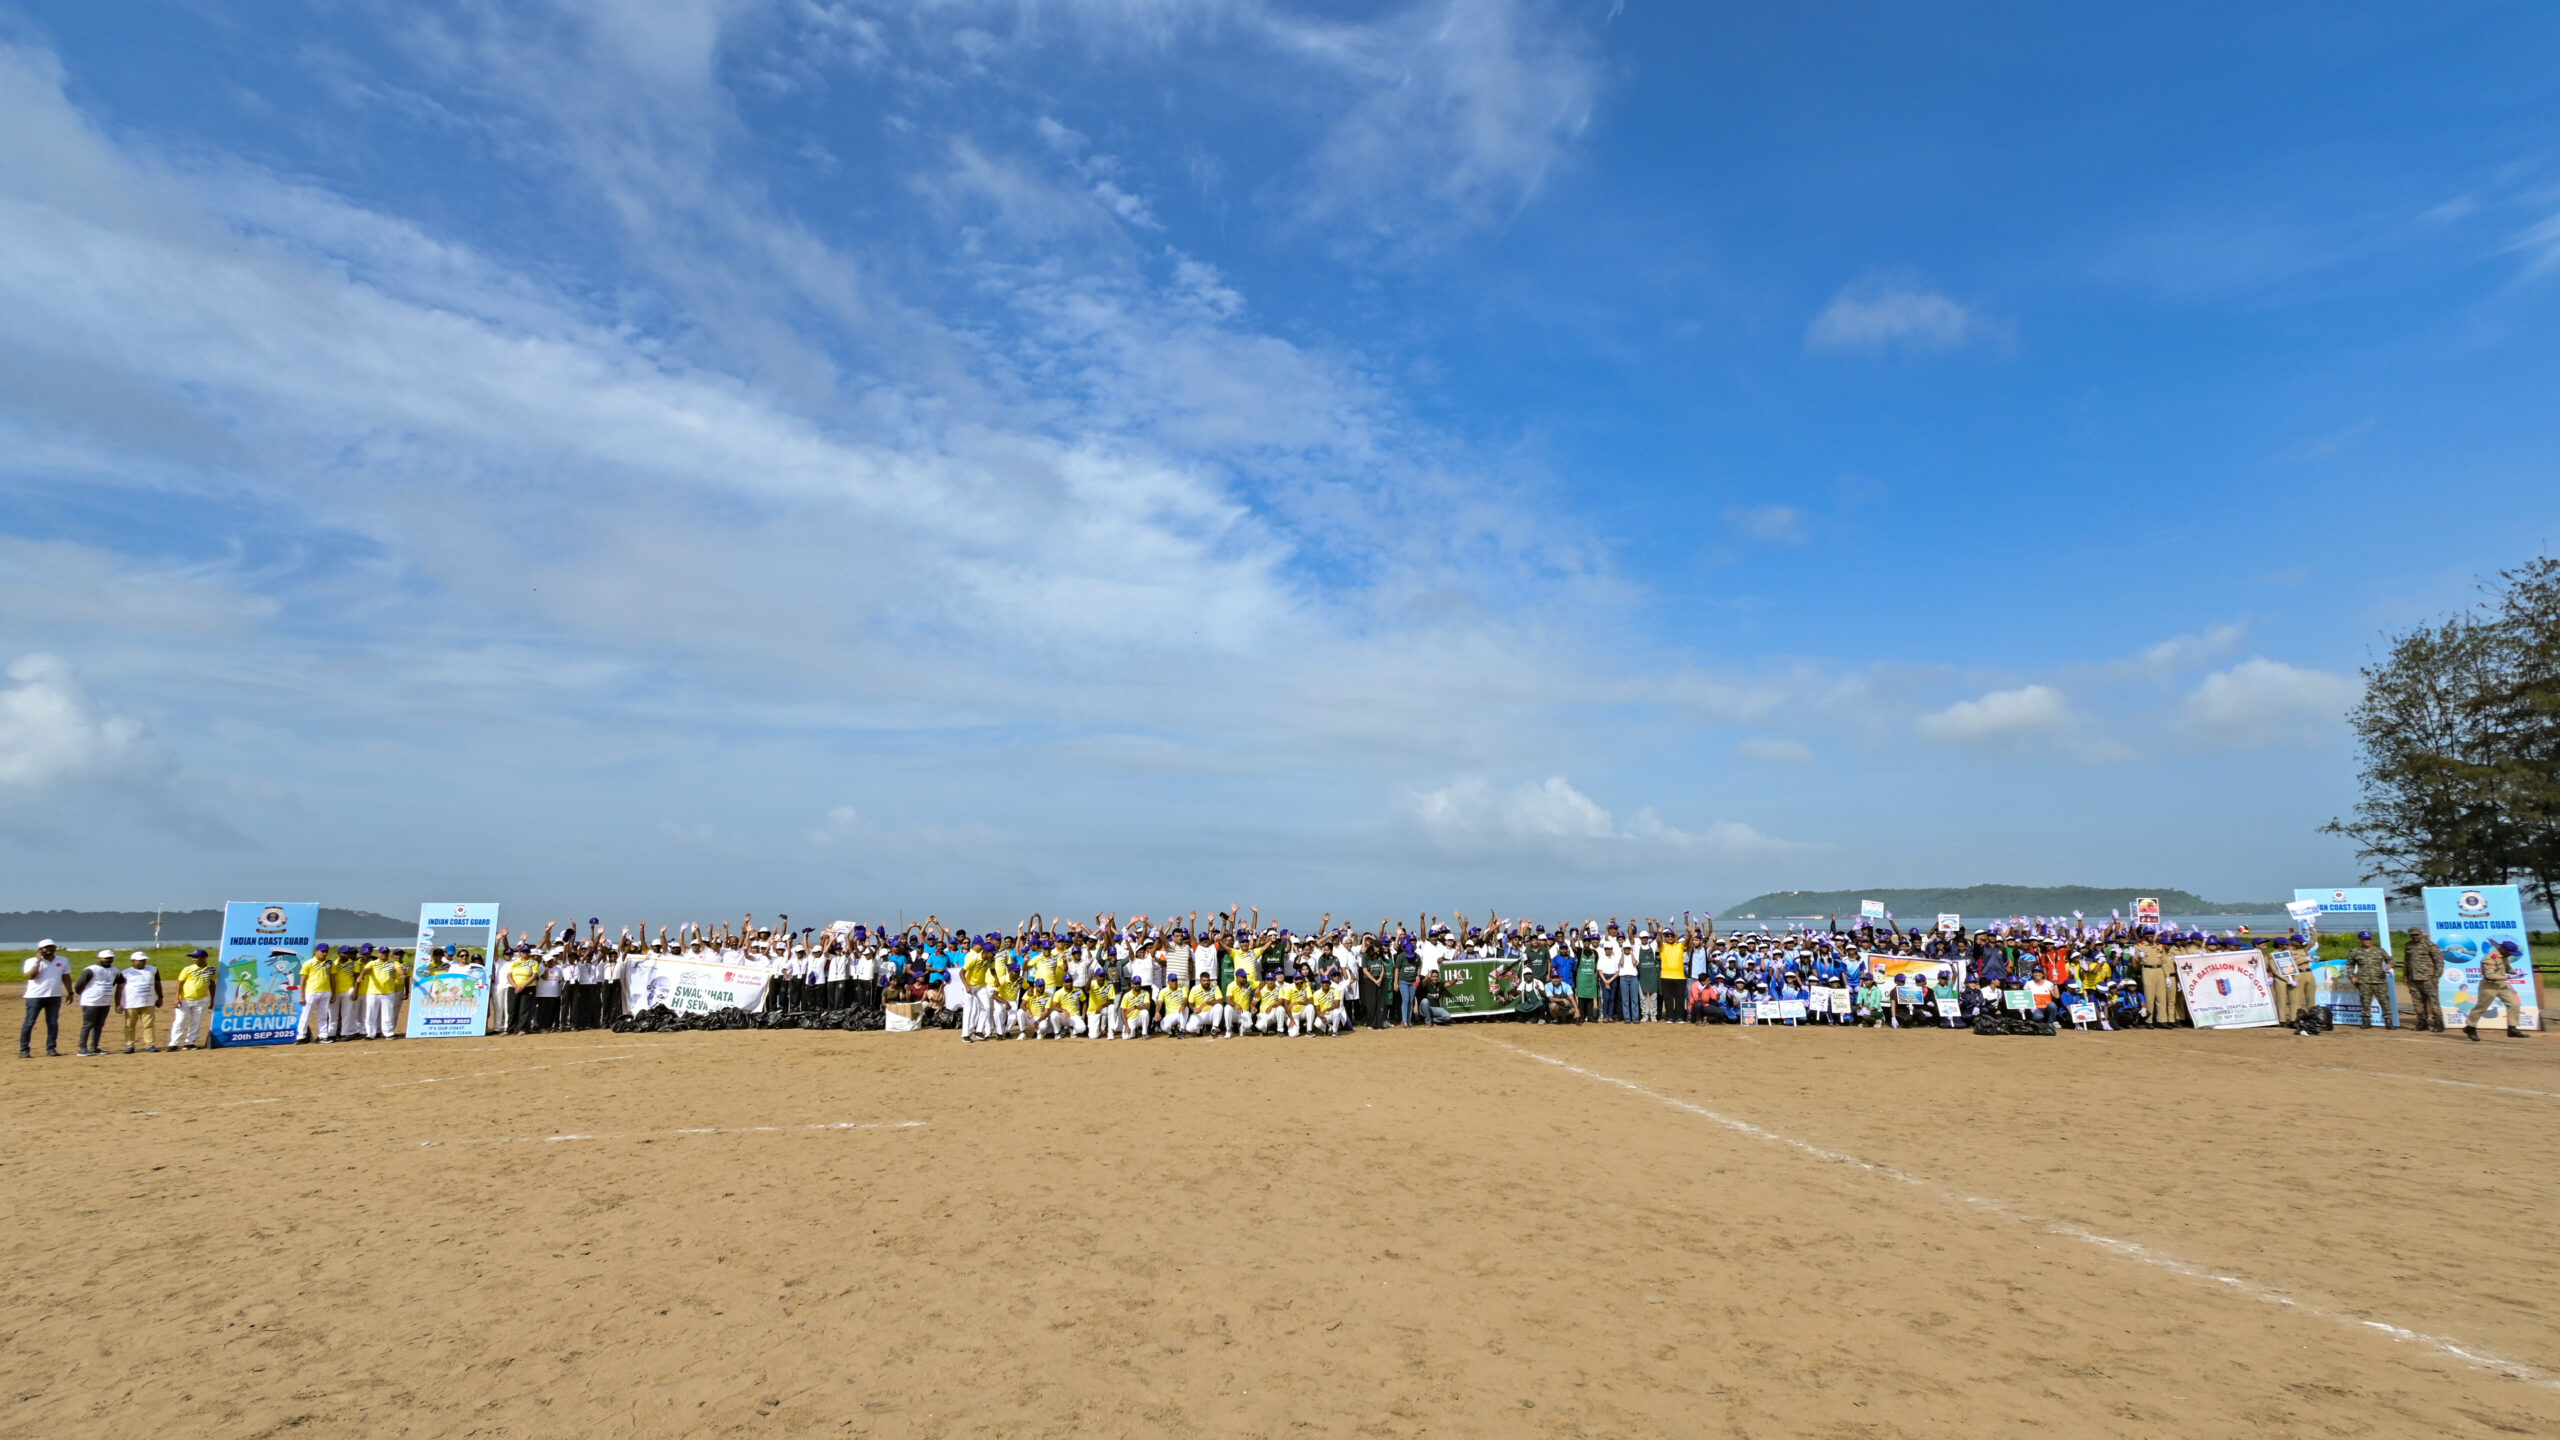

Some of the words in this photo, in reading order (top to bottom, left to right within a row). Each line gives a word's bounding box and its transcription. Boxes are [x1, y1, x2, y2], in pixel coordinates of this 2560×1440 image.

[428, 918, 448, 926] INDIAN
[449, 918, 469, 926] COAST
[470, 918, 490, 926] GUARD
[2436, 921, 2462, 930] INDIAN
[2463, 921, 2489, 929] COAST
[2490, 920, 2517, 929] GUARD
[230, 937, 257, 945] INDIAN
[257, 937, 282, 945] COAST
[283, 937, 309, 945] GUARD
[2188, 979, 2198, 997] GOA
[2196, 963, 2235, 980] BATTALION
[2237, 966, 2254, 980] NCC
[2253, 979, 2267, 998] GOA
[421, 996, 480, 1007] COASTAL
[671, 997, 684, 1008] HI
[686, 999, 708, 1012] SEVA
[222, 1003, 298, 1017] COASTAL
[419, 1007, 478, 1018] CLEANUP
[221, 1016, 297, 1032] CLEANUP
[232, 1033, 252, 1041] 20th
[274, 1030, 295, 1038] 2025
